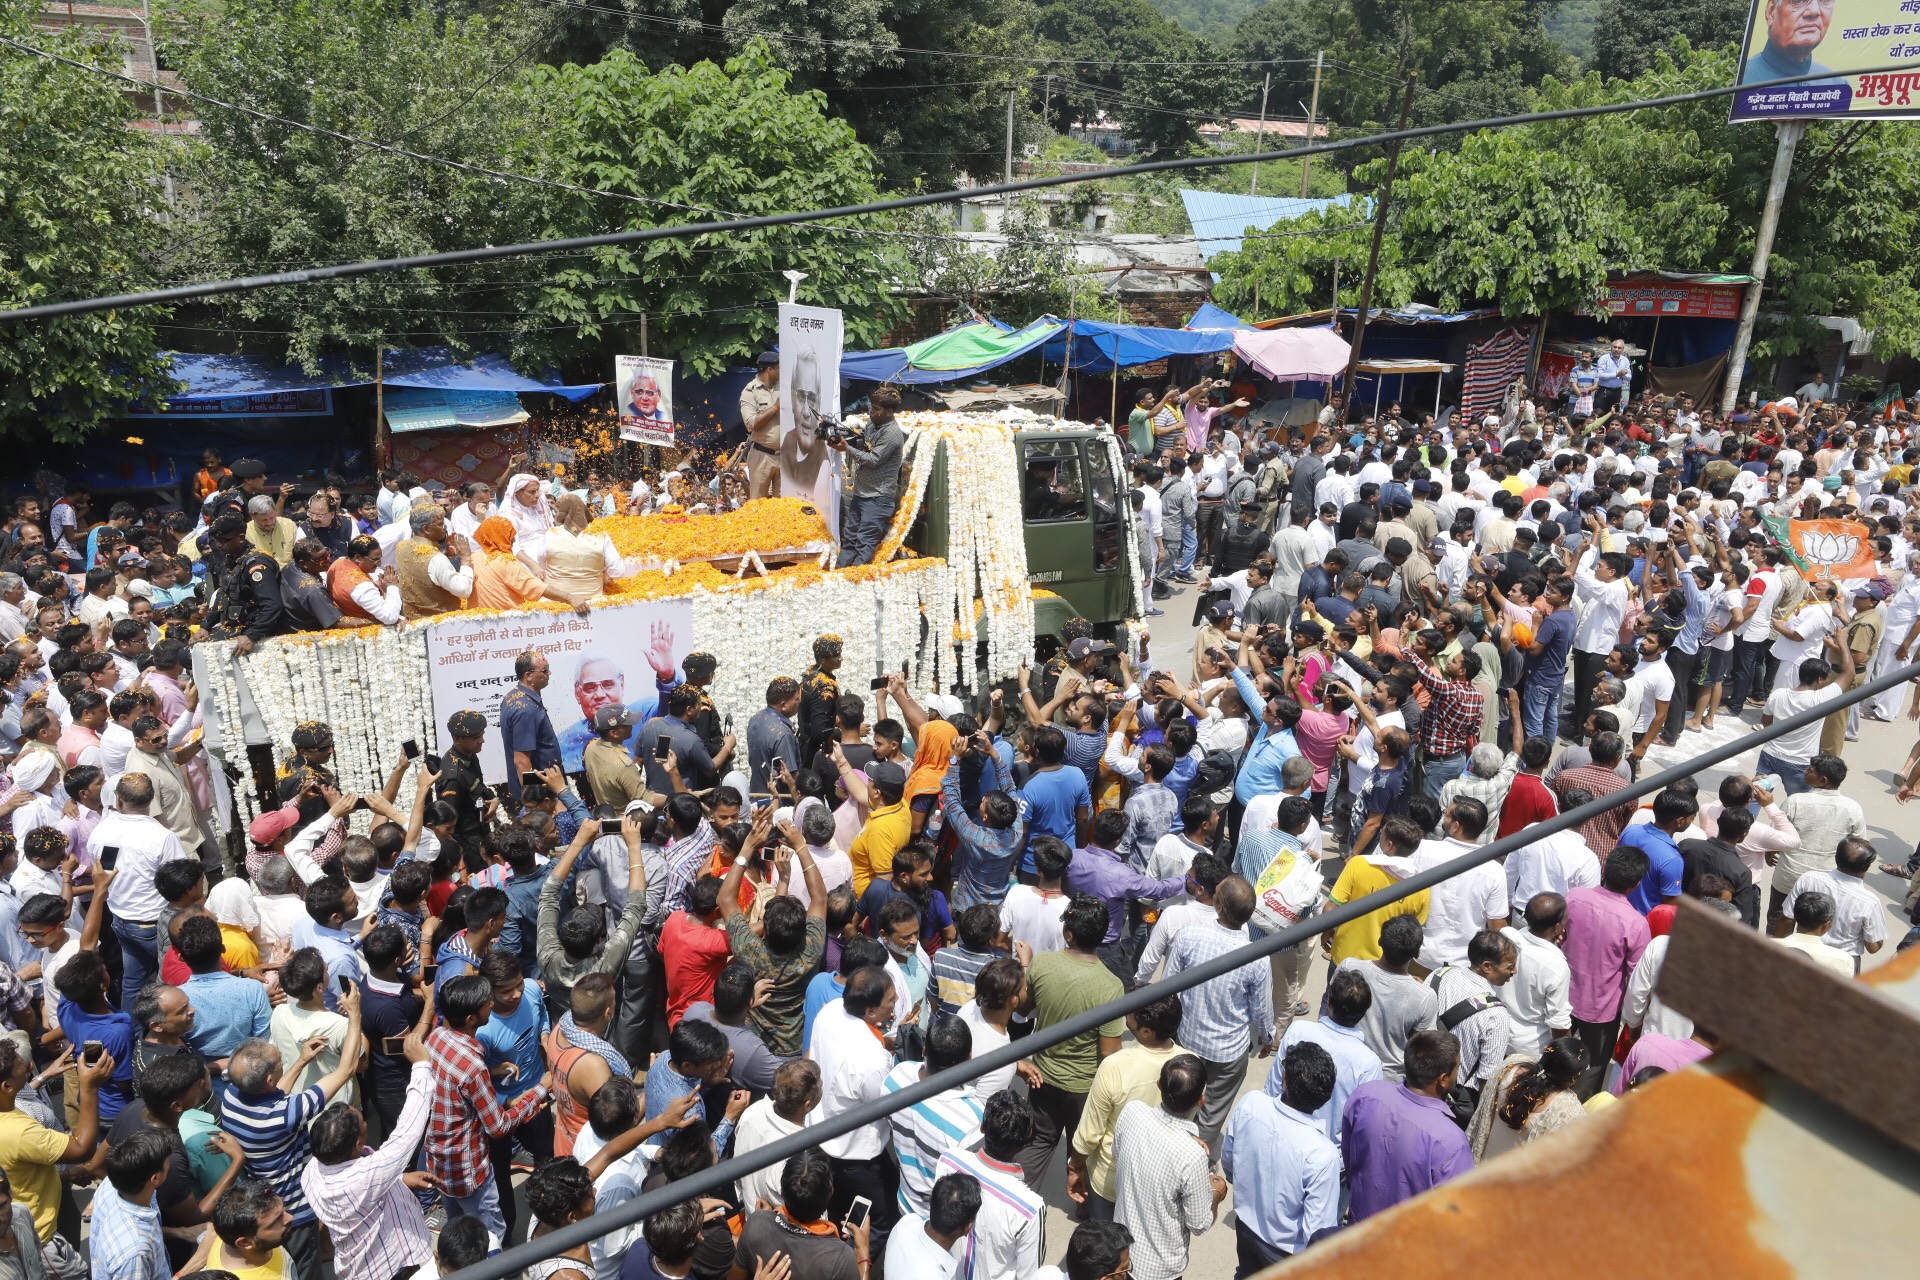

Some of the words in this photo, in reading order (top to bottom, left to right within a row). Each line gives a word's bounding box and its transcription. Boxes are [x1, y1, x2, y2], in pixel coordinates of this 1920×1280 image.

[1842, 28, 1869, 40] रास्ता
[1871, 23, 1892, 37] रोक
[1893, 24, 1912, 35] कर
[1788, 91, 1810, 102] बिहारी
[1811, 89, 1841, 101] वाजपेयी
[447, 635, 461, 646] हर
[499, 628, 509, 640] से
[512, 626, 523, 637] दो
[526, 626, 545, 637] हाथ
[547, 621, 565, 634] मैंने
[479, 648, 489, 660] में
[564, 639, 582, 651] दिए
[456, 680, 479, 690] शत्
[480, 677, 503, 686] शत्
